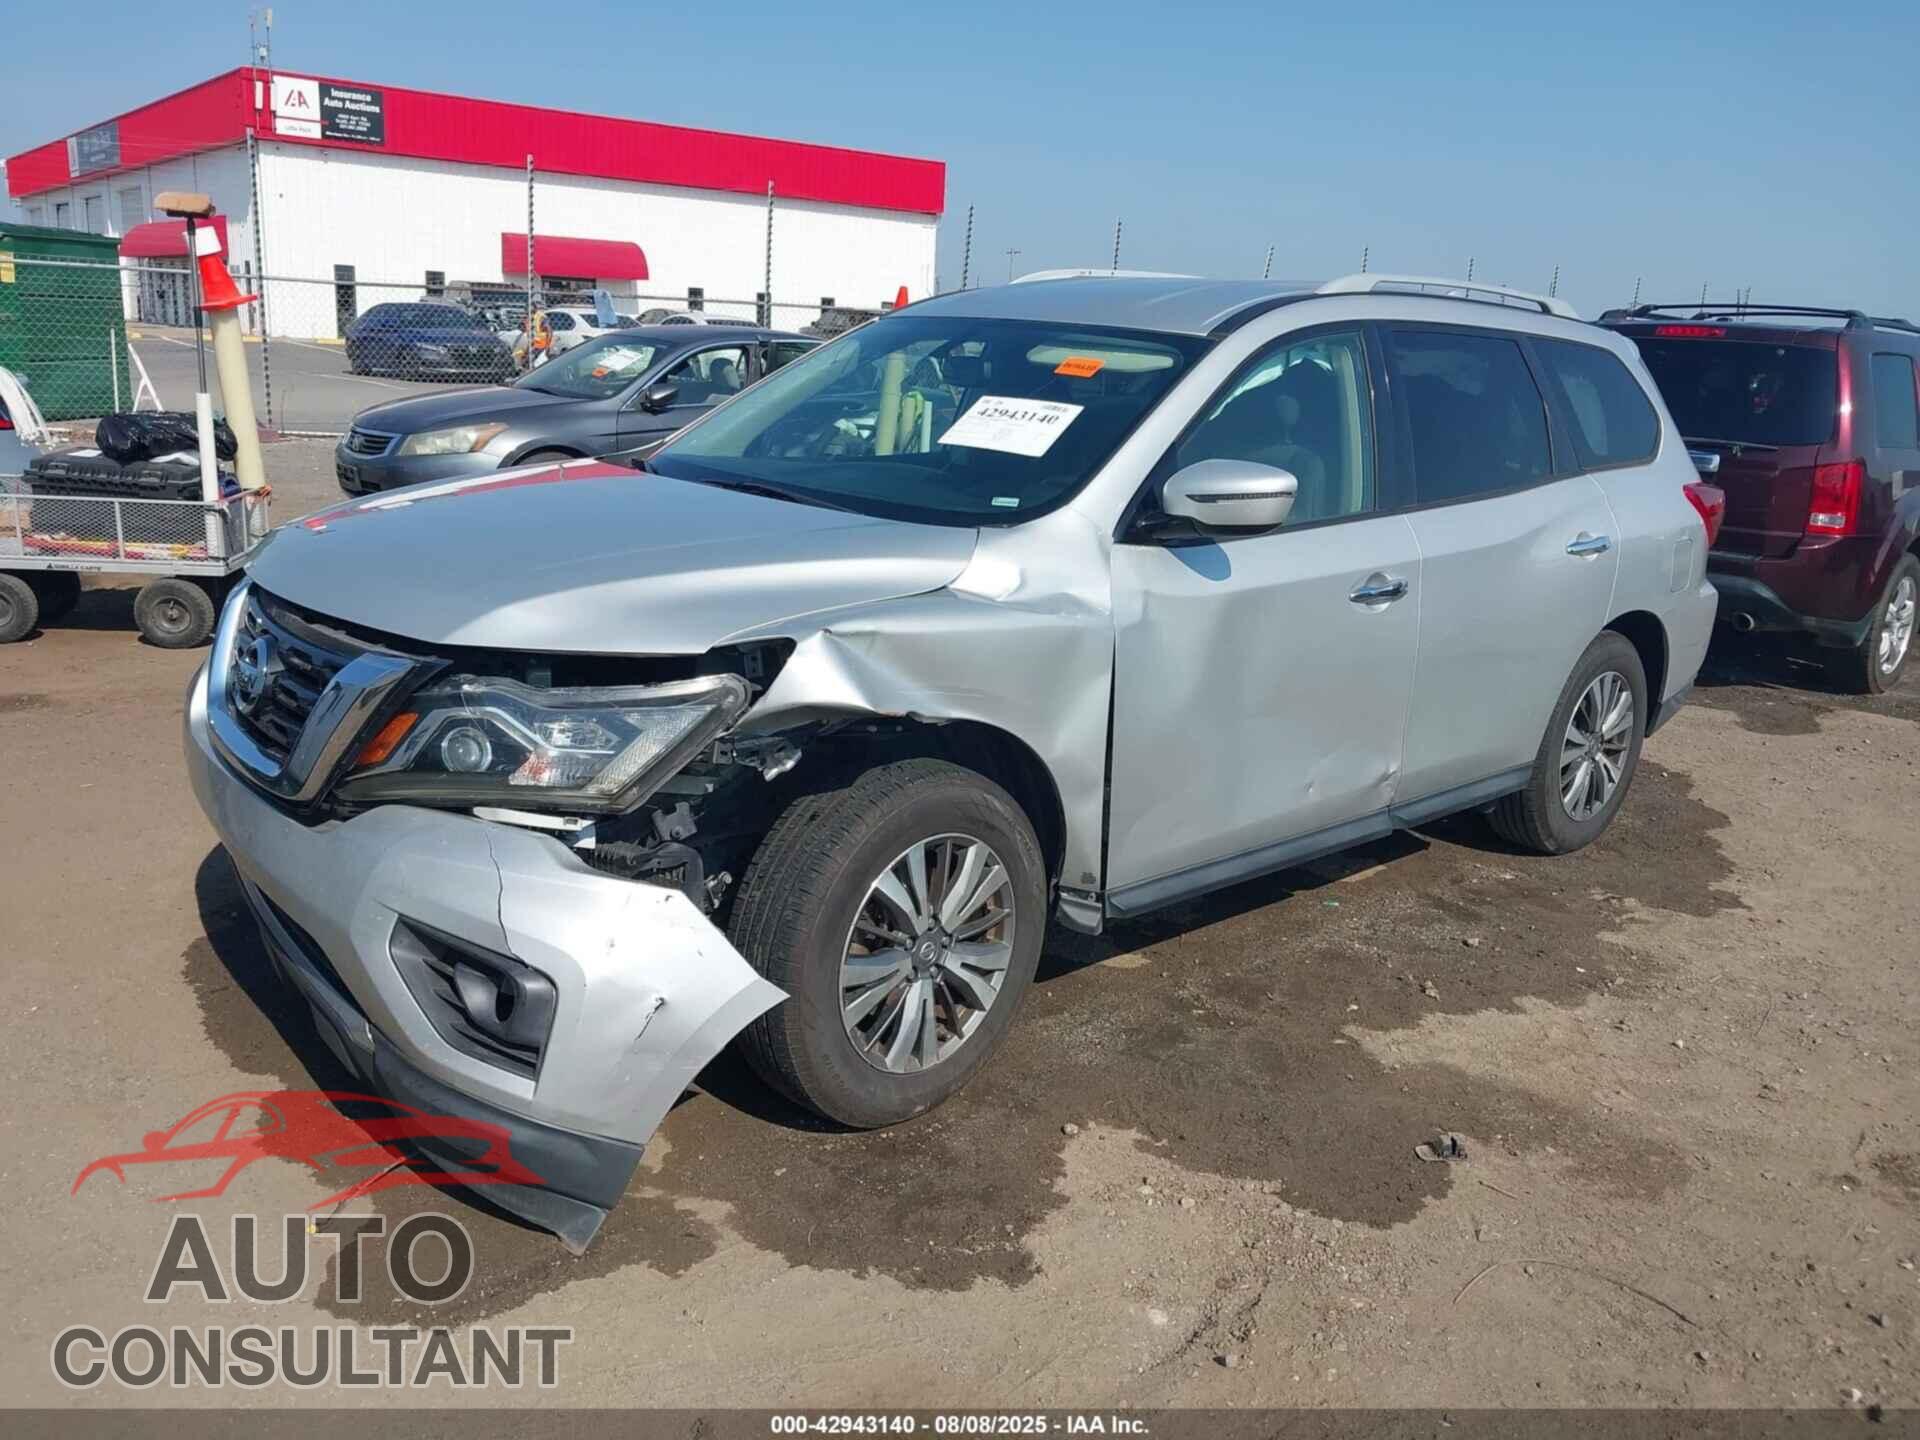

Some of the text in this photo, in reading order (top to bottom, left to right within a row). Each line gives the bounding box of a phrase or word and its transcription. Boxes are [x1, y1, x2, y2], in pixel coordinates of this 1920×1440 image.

[330, 87, 372, 102] Insurance
[323, 97, 380, 113] Auto Auctions
[976, 407, 1060, 425] 42943140
